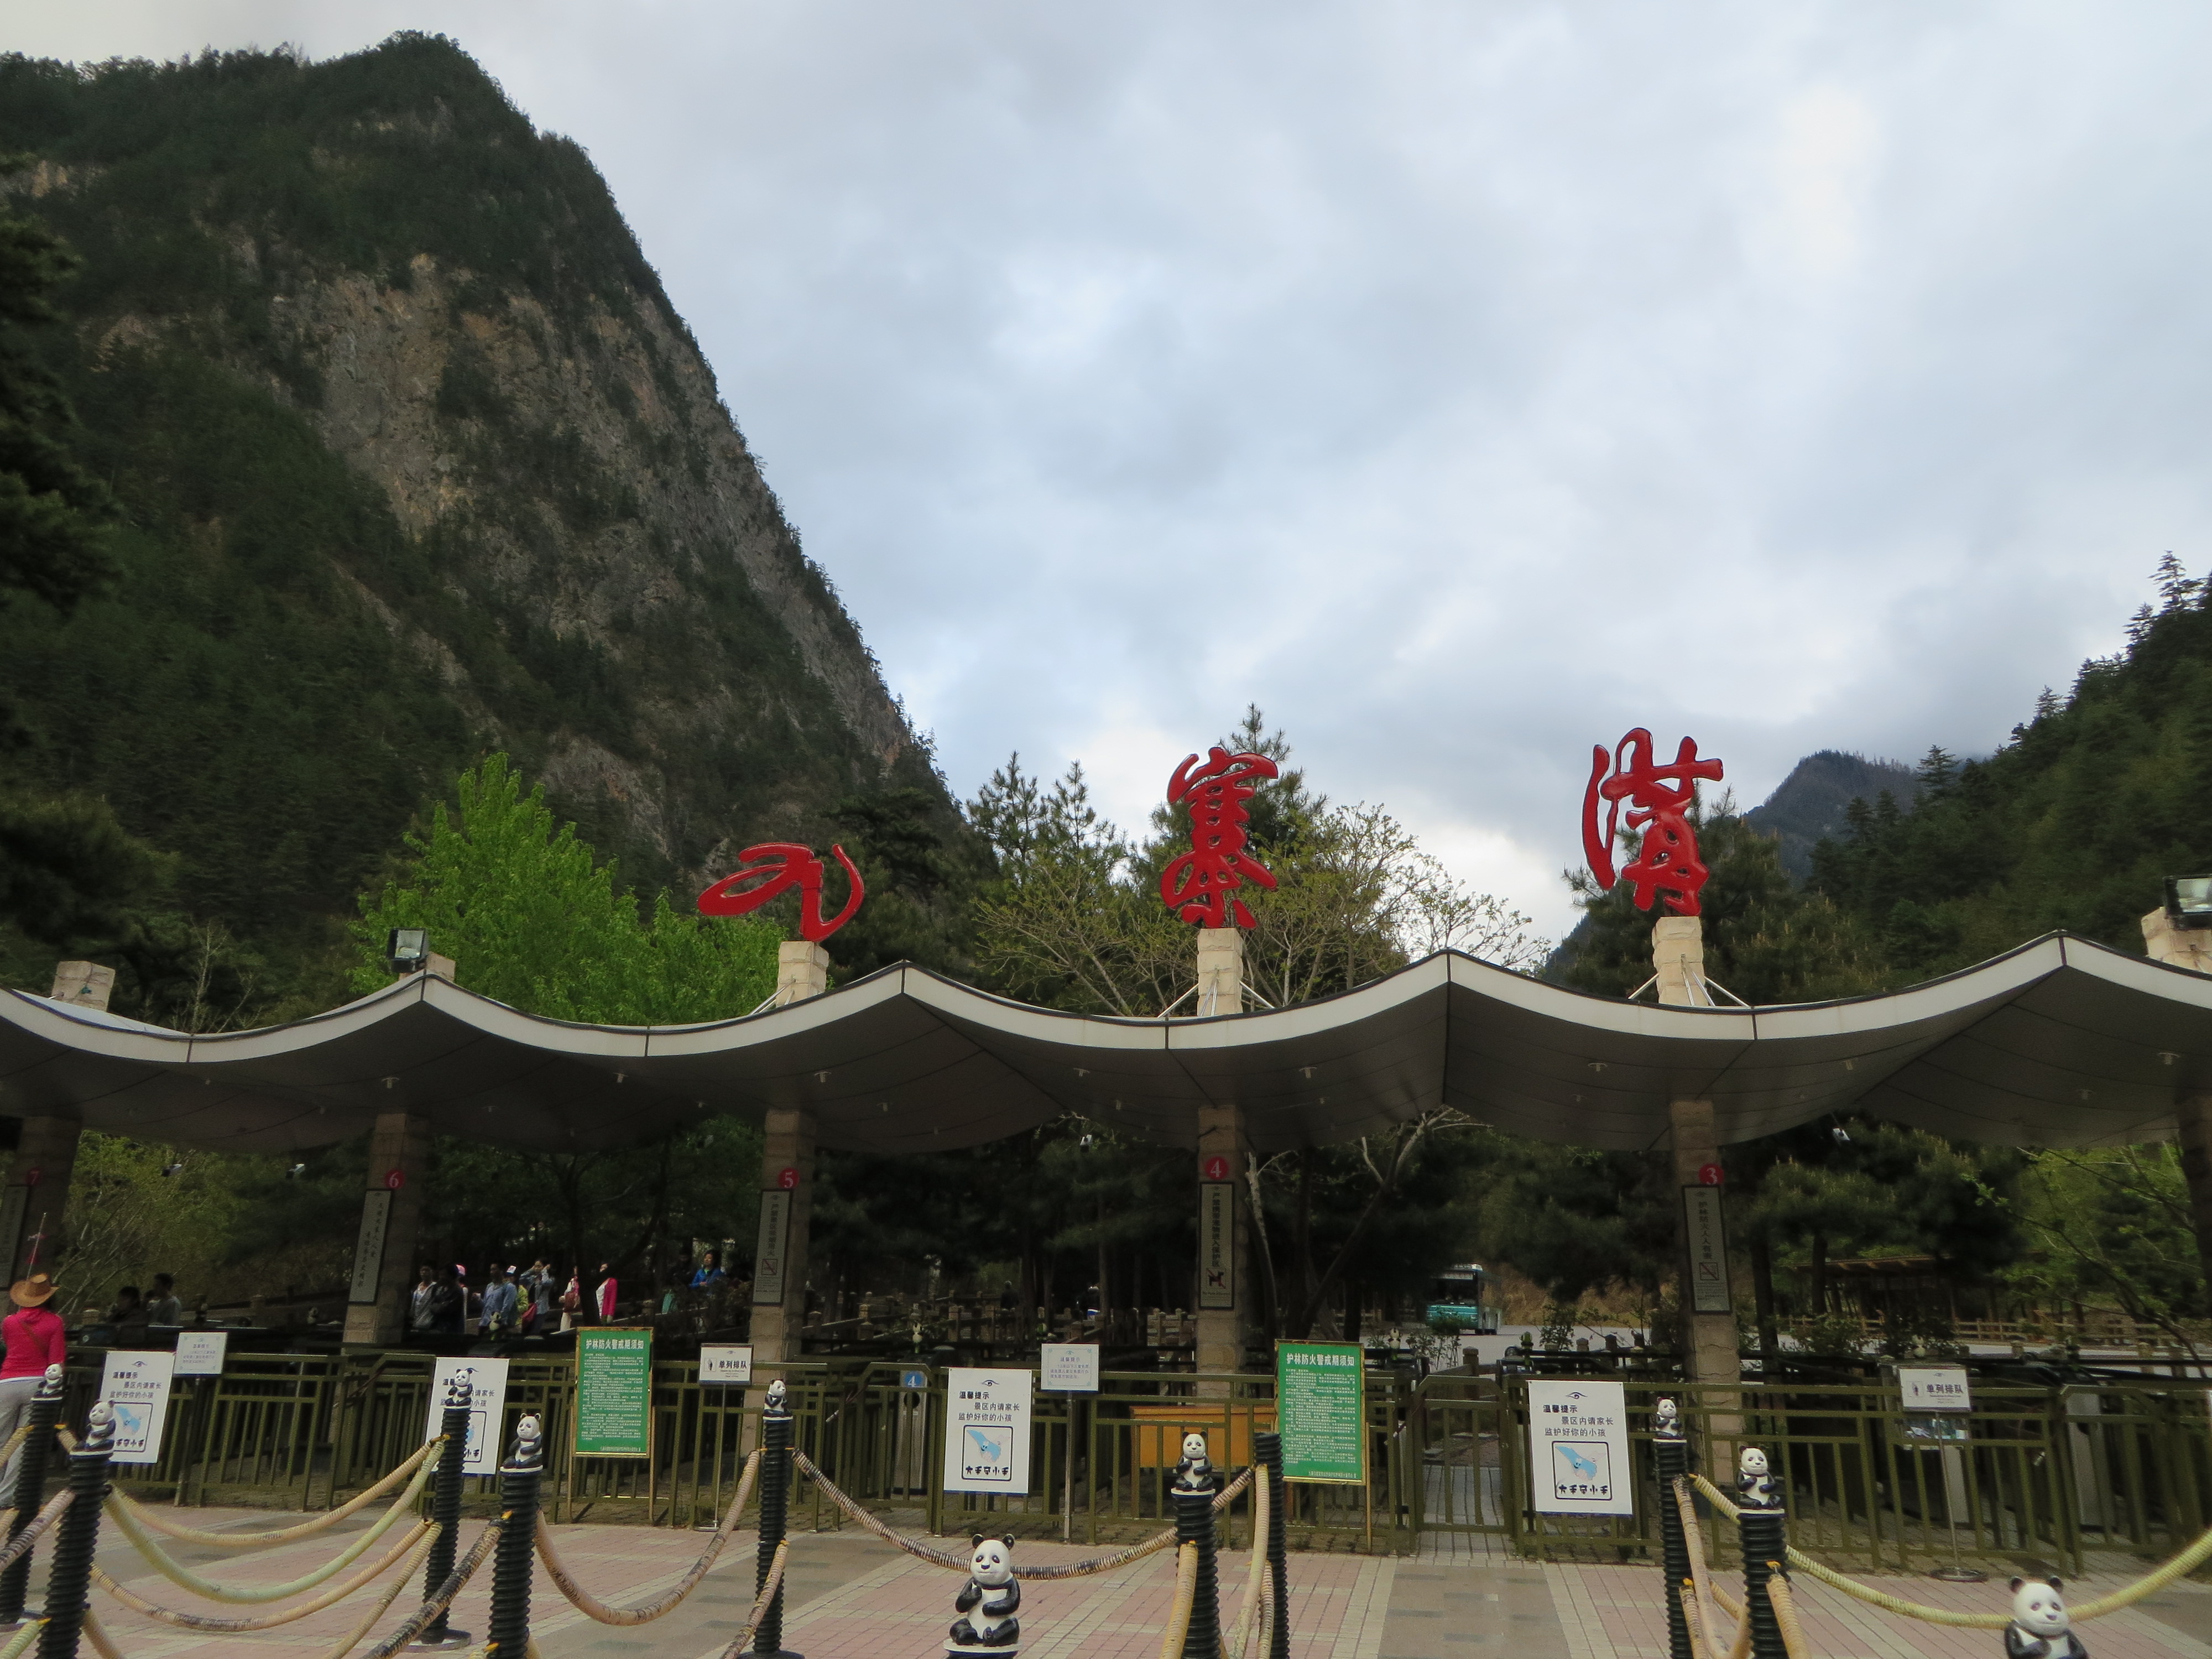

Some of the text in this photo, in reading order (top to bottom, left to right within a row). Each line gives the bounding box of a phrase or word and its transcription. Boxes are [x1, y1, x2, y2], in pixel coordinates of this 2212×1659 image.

[697, 842, 864, 941] 九
[1160, 747, 1279, 928] 寨
[1211, 1160, 1222, 1178] 4
[30, 1171, 39, 1185] 7
[389, 1172, 400, 1188] 6
[784, 1171, 794, 1188] 5
[1706, 1167, 1718, 1185] 3
[586, 1339, 644, 1350] 护林防火警戒期须知
[718, 1360, 747, 1369] 单列排队
[1286, 1353, 1355, 1366] 护林防火警戒期须知
[907, 1375, 916, 1387] 4
[1926, 1384, 1964, 1394] 单列排队
[109, 1391, 154, 1399] 监护好你的小孩
[959, 1391, 989, 1400] 温馨提示
[974, 1402, 1020, 1411] 景区内请家长
[1543, 1405, 1578, 1413] 温馨提示
[958, 1412, 1012, 1422] 监护好你的小孩
[1561, 1416, 1614, 1426] 景区内请家长
[1545, 1427, 1606, 1437] 监护好你的小孩
